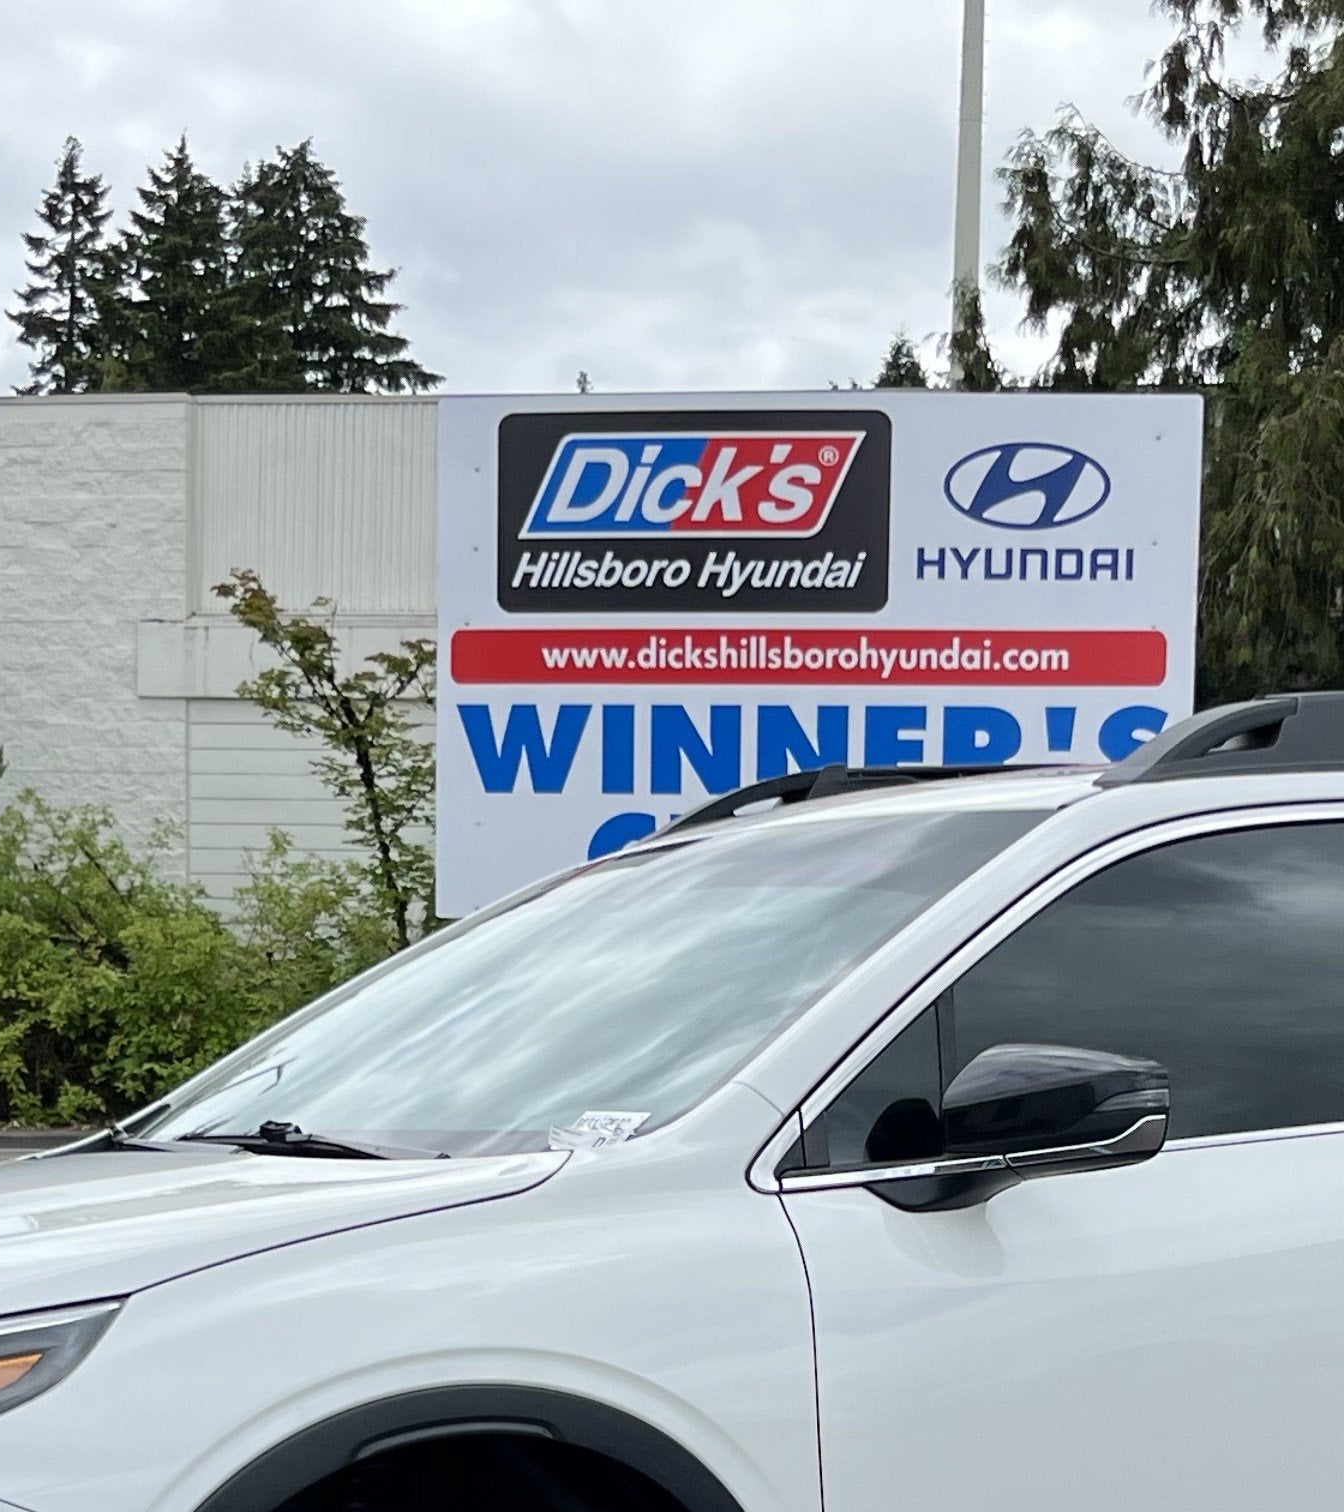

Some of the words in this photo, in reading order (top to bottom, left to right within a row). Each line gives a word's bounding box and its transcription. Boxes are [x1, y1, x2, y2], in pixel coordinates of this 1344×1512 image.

[511, 551, 691, 588] Hillsboro
[697, 551, 867, 597] Hyundai
[917, 546, 1134, 582] HYUNDAI
[542, 635, 1069, 679] www.dickshillsborohyundai.com
